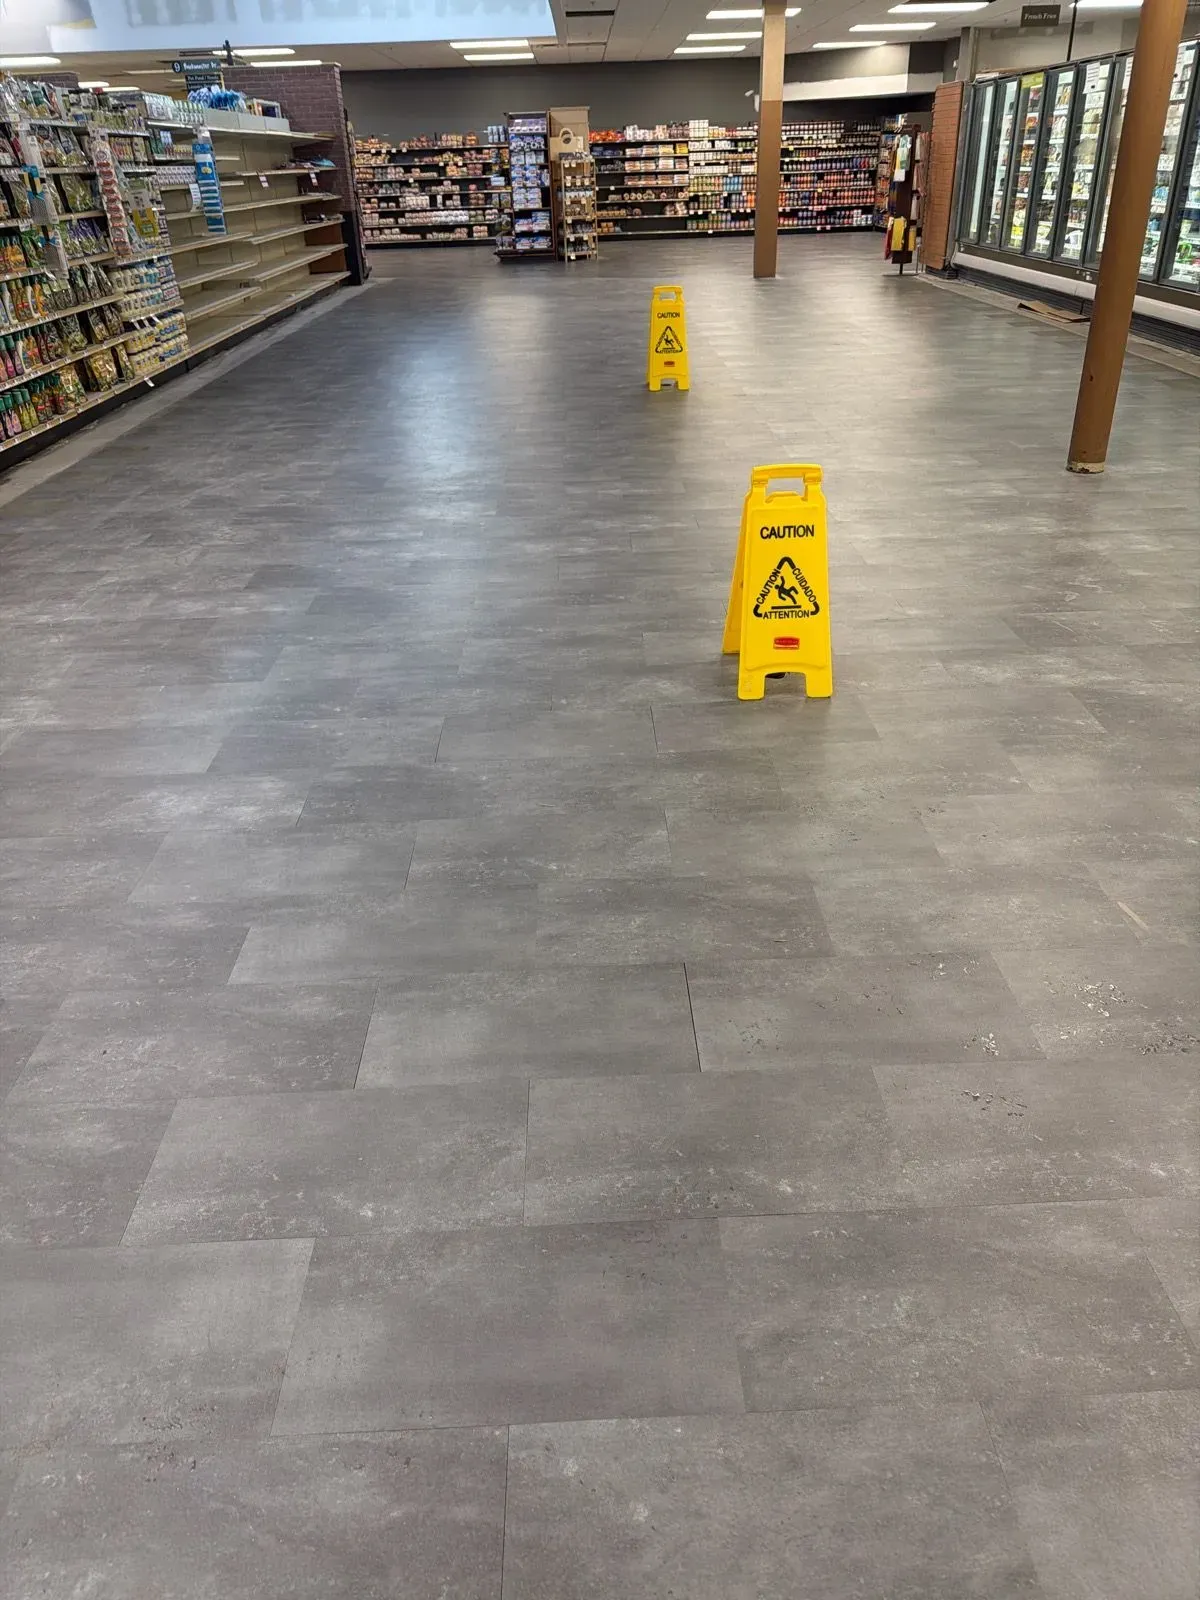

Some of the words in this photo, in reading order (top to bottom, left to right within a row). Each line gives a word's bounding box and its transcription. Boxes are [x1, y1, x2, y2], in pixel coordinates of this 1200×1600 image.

[174, 62, 180, 72] 9
[760, 525, 815, 540] CAUTION
[756, 568, 781, 605] CAUTION
[792, 567, 817, 603] CUIDADO
[763, 610, 810, 620] ATTENTION
